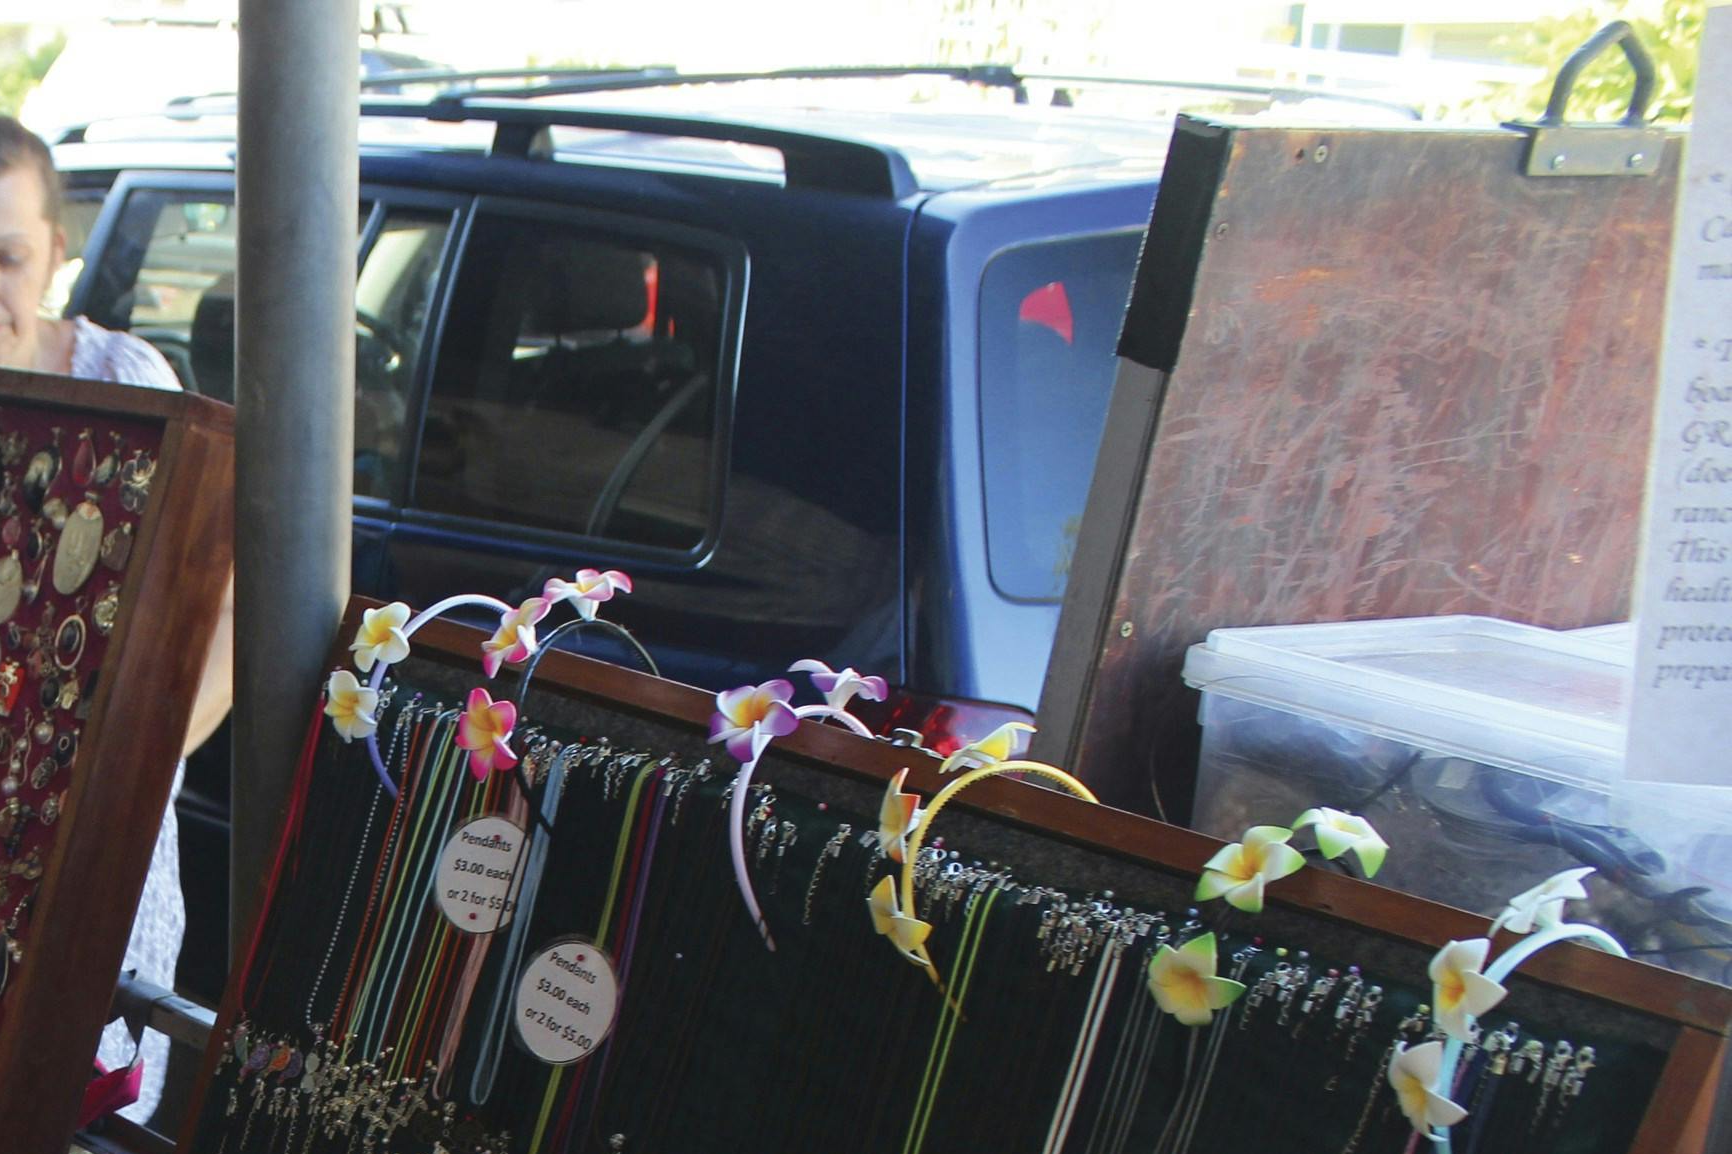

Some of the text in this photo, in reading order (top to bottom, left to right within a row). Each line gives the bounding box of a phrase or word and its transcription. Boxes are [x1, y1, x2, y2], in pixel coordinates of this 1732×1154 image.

[462, 831, 512, 852] Pendants
[453, 858, 512, 880] $3.00 each
[447, 889, 460, 898] or
[460, 890, 469, 902] 2
[470, 891, 487, 906] for
[549, 951, 597, 984] Pendants
[537, 978, 590, 1015] $3.00 each
[525, 1008, 593, 1050] or 2 for $5.00
